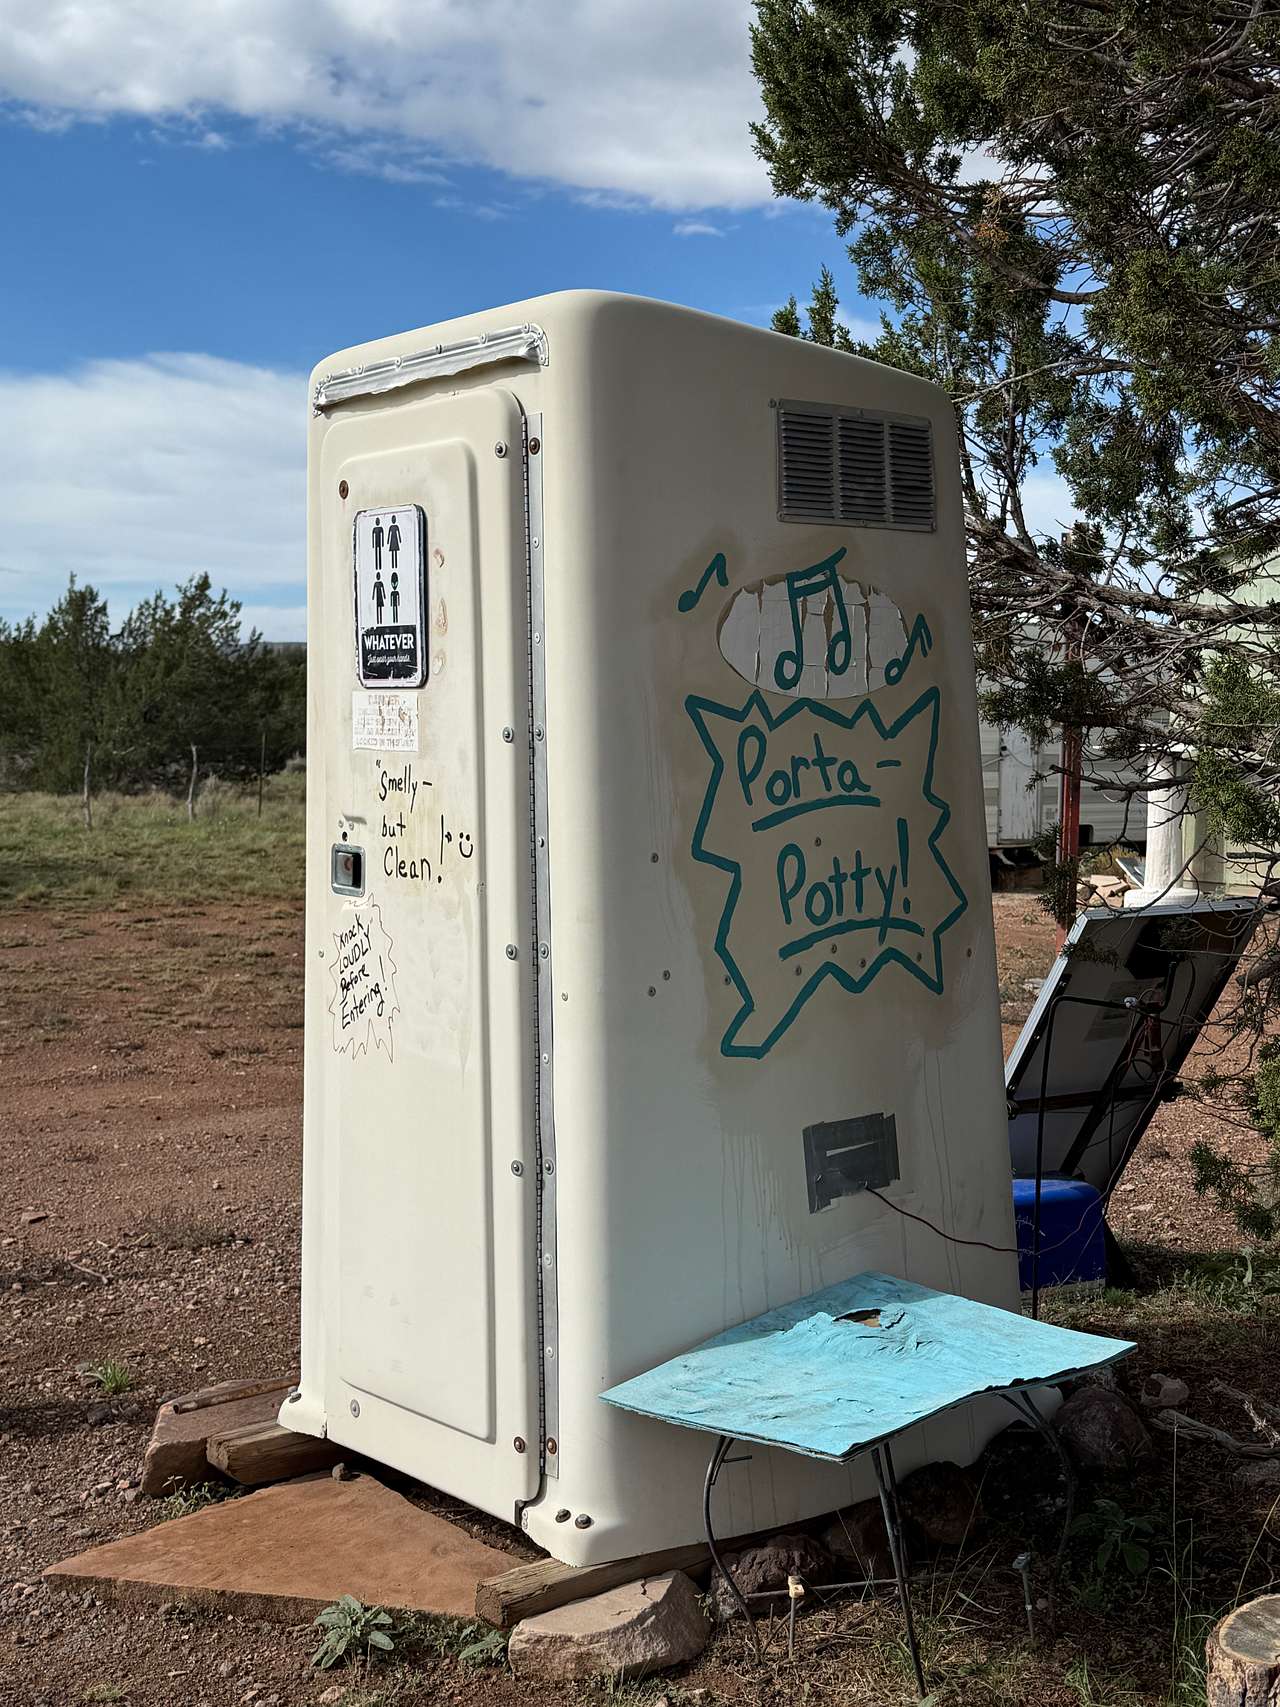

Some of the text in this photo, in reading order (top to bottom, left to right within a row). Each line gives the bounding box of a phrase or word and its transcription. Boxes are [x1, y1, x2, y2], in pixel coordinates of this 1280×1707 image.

[364, 633, 414, 650] WHATEVER
[382, 812, 407, 837] but
[777, 817, 911, 946] Potty!
[340, 924, 372, 975] LOUDLY
[340, 963, 370, 1006] Before
[342, 954, 388, 1030] Entering!
